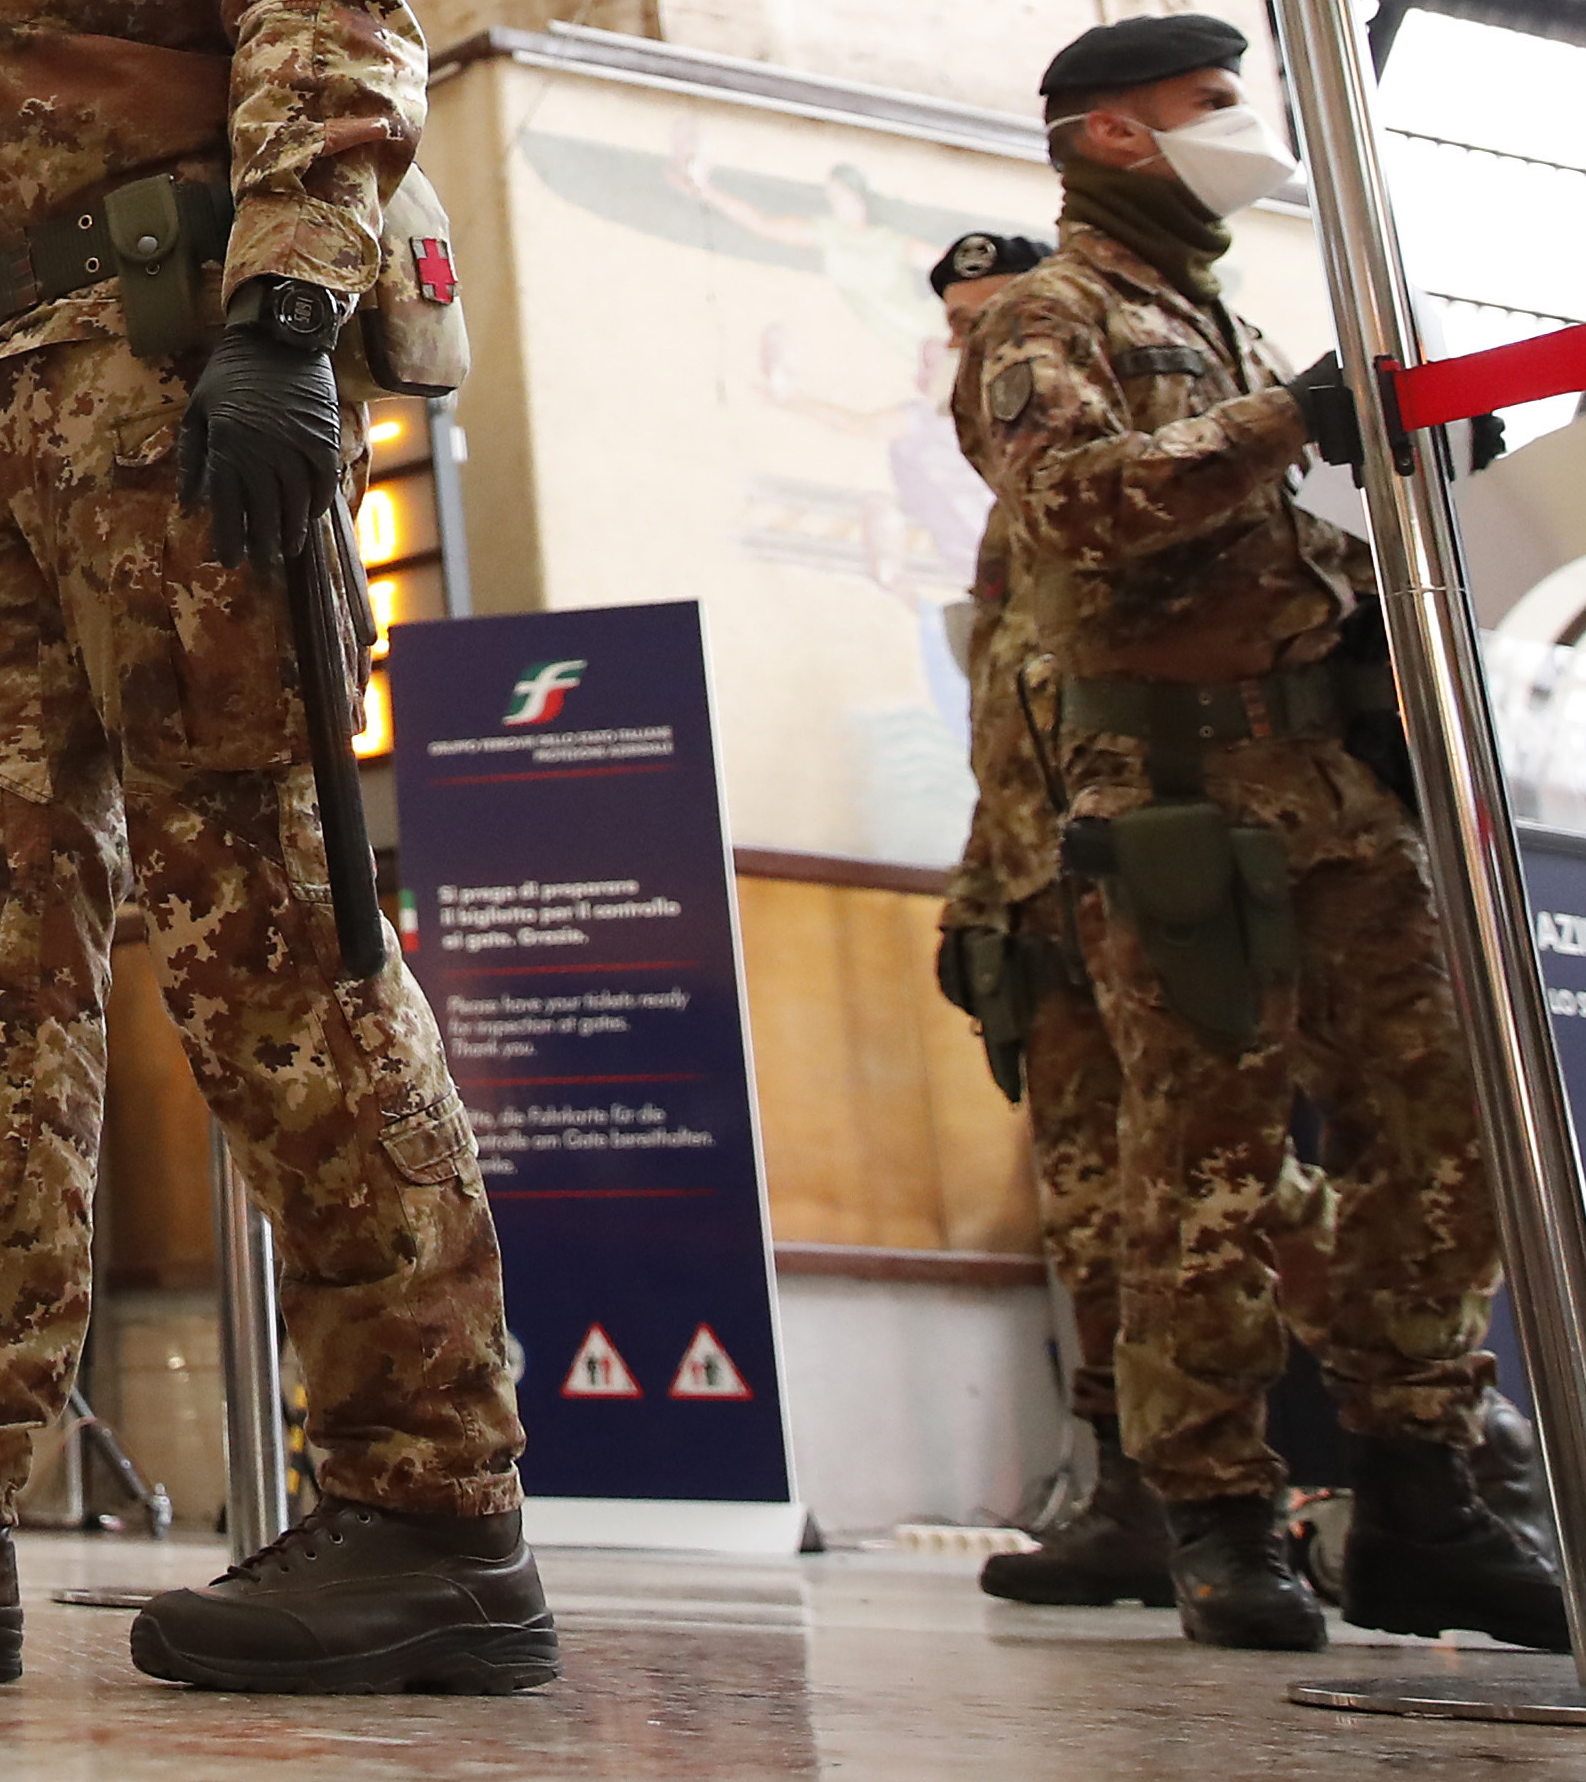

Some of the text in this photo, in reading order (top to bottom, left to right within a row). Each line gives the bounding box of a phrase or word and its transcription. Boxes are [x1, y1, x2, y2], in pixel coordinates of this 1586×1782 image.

[438, 879, 639, 906] Si prega di preparare
[455, 905, 538, 929] biglietto
[539, 906, 574, 926] per
[575, 900, 592, 919] il
[592, 896, 681, 919] controllo
[639, 987, 690, 1012] ready
